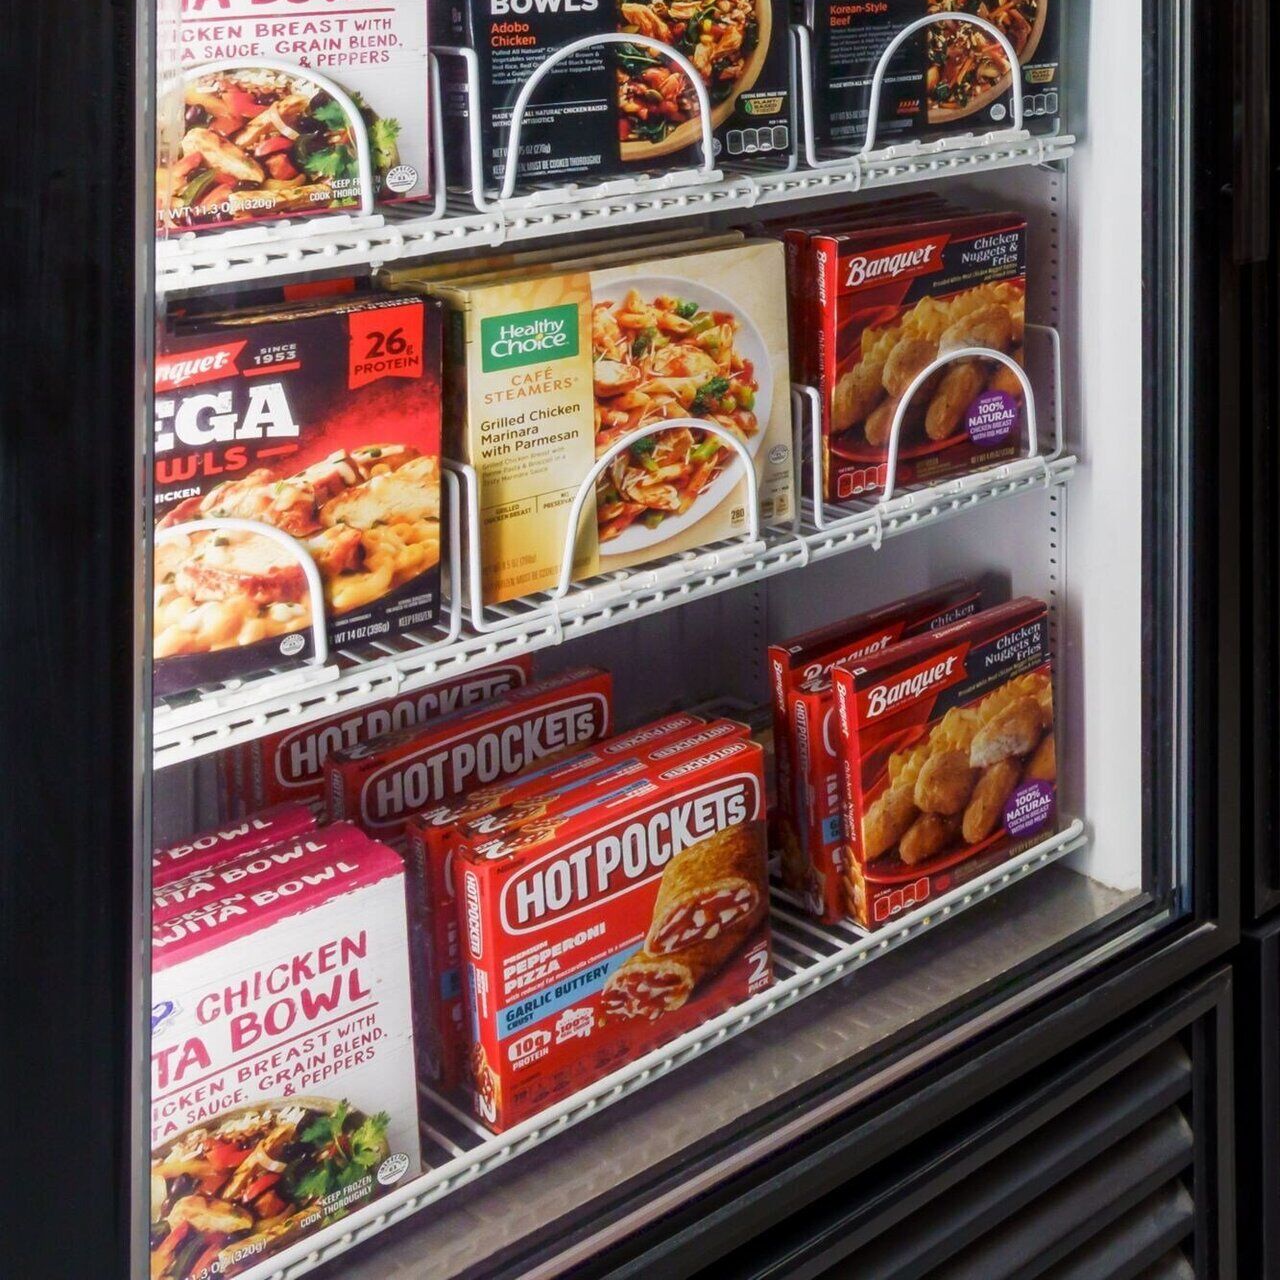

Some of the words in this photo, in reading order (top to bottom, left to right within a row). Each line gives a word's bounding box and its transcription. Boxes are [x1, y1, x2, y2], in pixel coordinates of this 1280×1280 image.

[830, 2, 888, 15] Korean-Style
[830, 15, 851, 26] Beef
[255, 19, 348, 37] BREAST
[354, 18, 392, 32] WITH
[491, 22, 529, 33] Adobo
[491, 34, 536, 47] Chicken
[274, 37, 342, 54] GRAIN
[317, 50, 391, 68] PEPPERS
[309, 191, 330, 201] COOK
[974, 232, 1019, 250] Chicken
[846, 244, 936, 288] Banquet
[499, 319, 564, 340] Healthy
[253, 349, 297, 366] 1953
[259, 342, 297, 355] SINCE
[490, 330, 567, 358] Choice
[353, 355, 420, 376] PROTEIN
[511, 367, 553, 387] CAFÉ
[483, 379, 574, 405] STEAMERS
[480, 412, 525, 433] Grilled
[529, 401, 581, 423] Chicken
[969, 409, 1015, 427] NATURAL
[979, 401, 1004, 414] 100%
[480, 424, 539, 446] Marinara
[482, 443, 512, 459] with
[515, 428, 579, 453] Parmesan
[995, 621, 1042, 650] Chicken
[865, 654, 958, 719] Banquet
[375, 750, 450, 819] HOT
[451, 702, 598, 794] POCKETS
[1007, 795, 1051, 822] NATURAL
[220, 841, 328, 884] BOWL
[516, 844, 593, 924] HOT
[596, 782, 748, 893] POCKETS
[250, 861, 359, 906] BOWL
[503, 922, 606, 981] PEPPERONI
[194, 928, 368, 1027] CHICKEN
[504, 959, 561, 995] PIZZA
[505, 991, 552, 1022] GARLIC
[555, 963, 610, 999] BUTTERY
[231, 967, 372, 1055] BOWL
[237, 1031, 328, 1083] BREAST
[337, 1012, 377, 1040] WITH
[259, 1050, 326, 1092] GRAIN
[301, 1047, 377, 1088] PEPPERS
[322, 1189, 341, 1206] KEEP
[342, 1176, 372, 1196] FROZEN
[323, 1185, 373, 1216] THOROUGHLY
